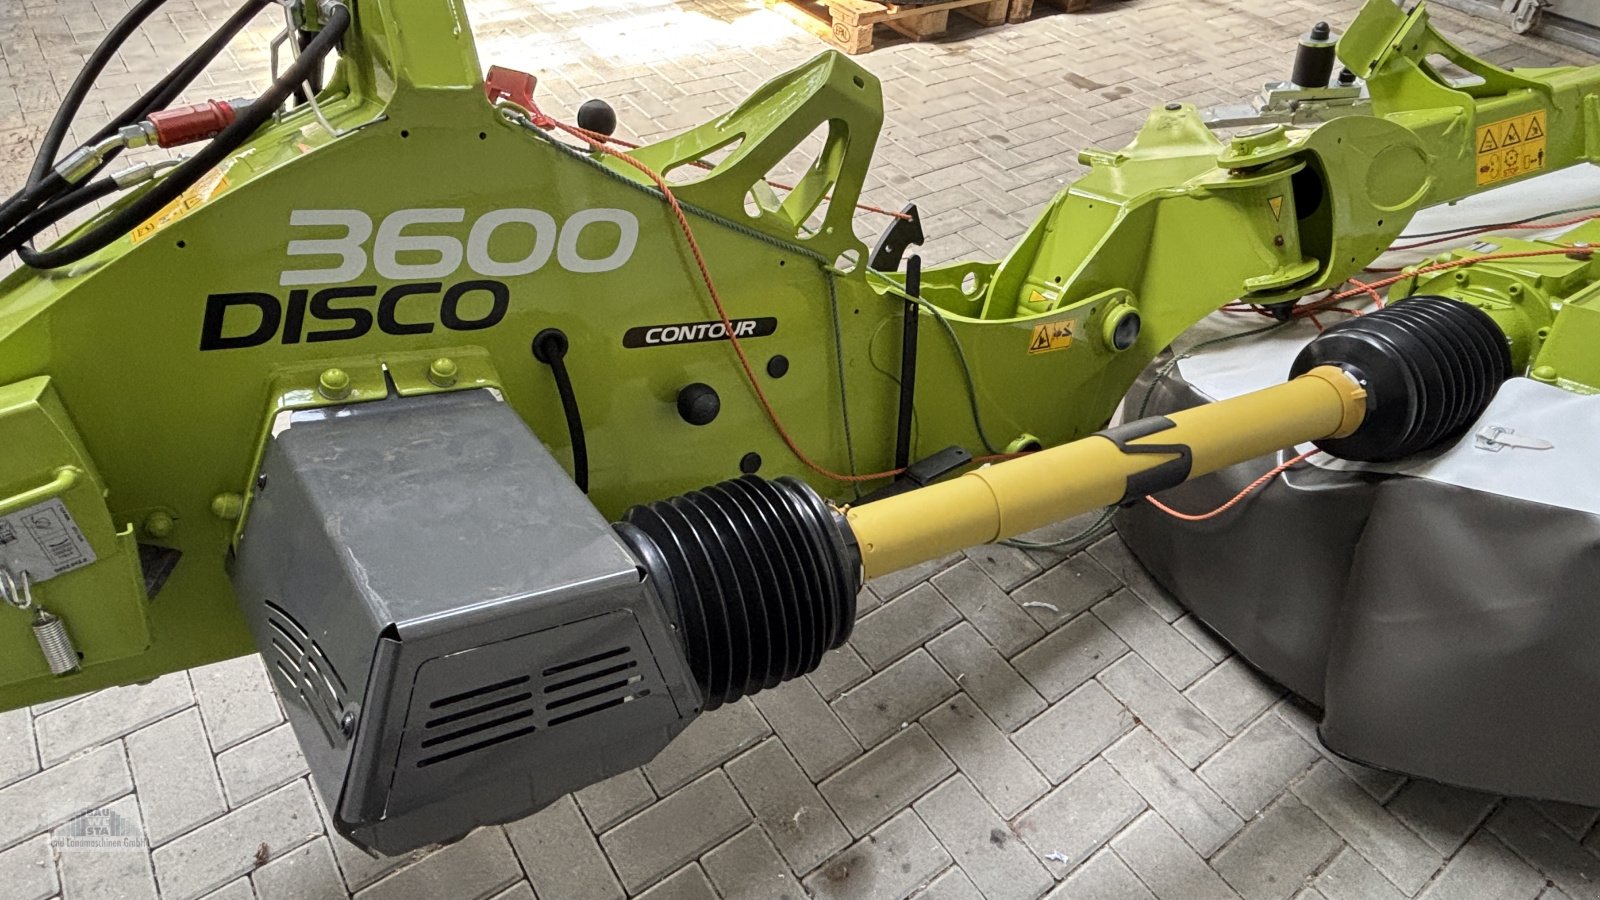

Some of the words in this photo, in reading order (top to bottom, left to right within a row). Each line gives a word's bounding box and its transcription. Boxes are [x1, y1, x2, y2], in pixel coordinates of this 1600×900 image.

[835, 25, 848, 40] EPAL
[1503, 166, 1519, 177] STOP
[279, 207, 639, 286] 3600
[199, 280, 510, 351] DISCO
[645, 320, 757, 344] CONTOUR
